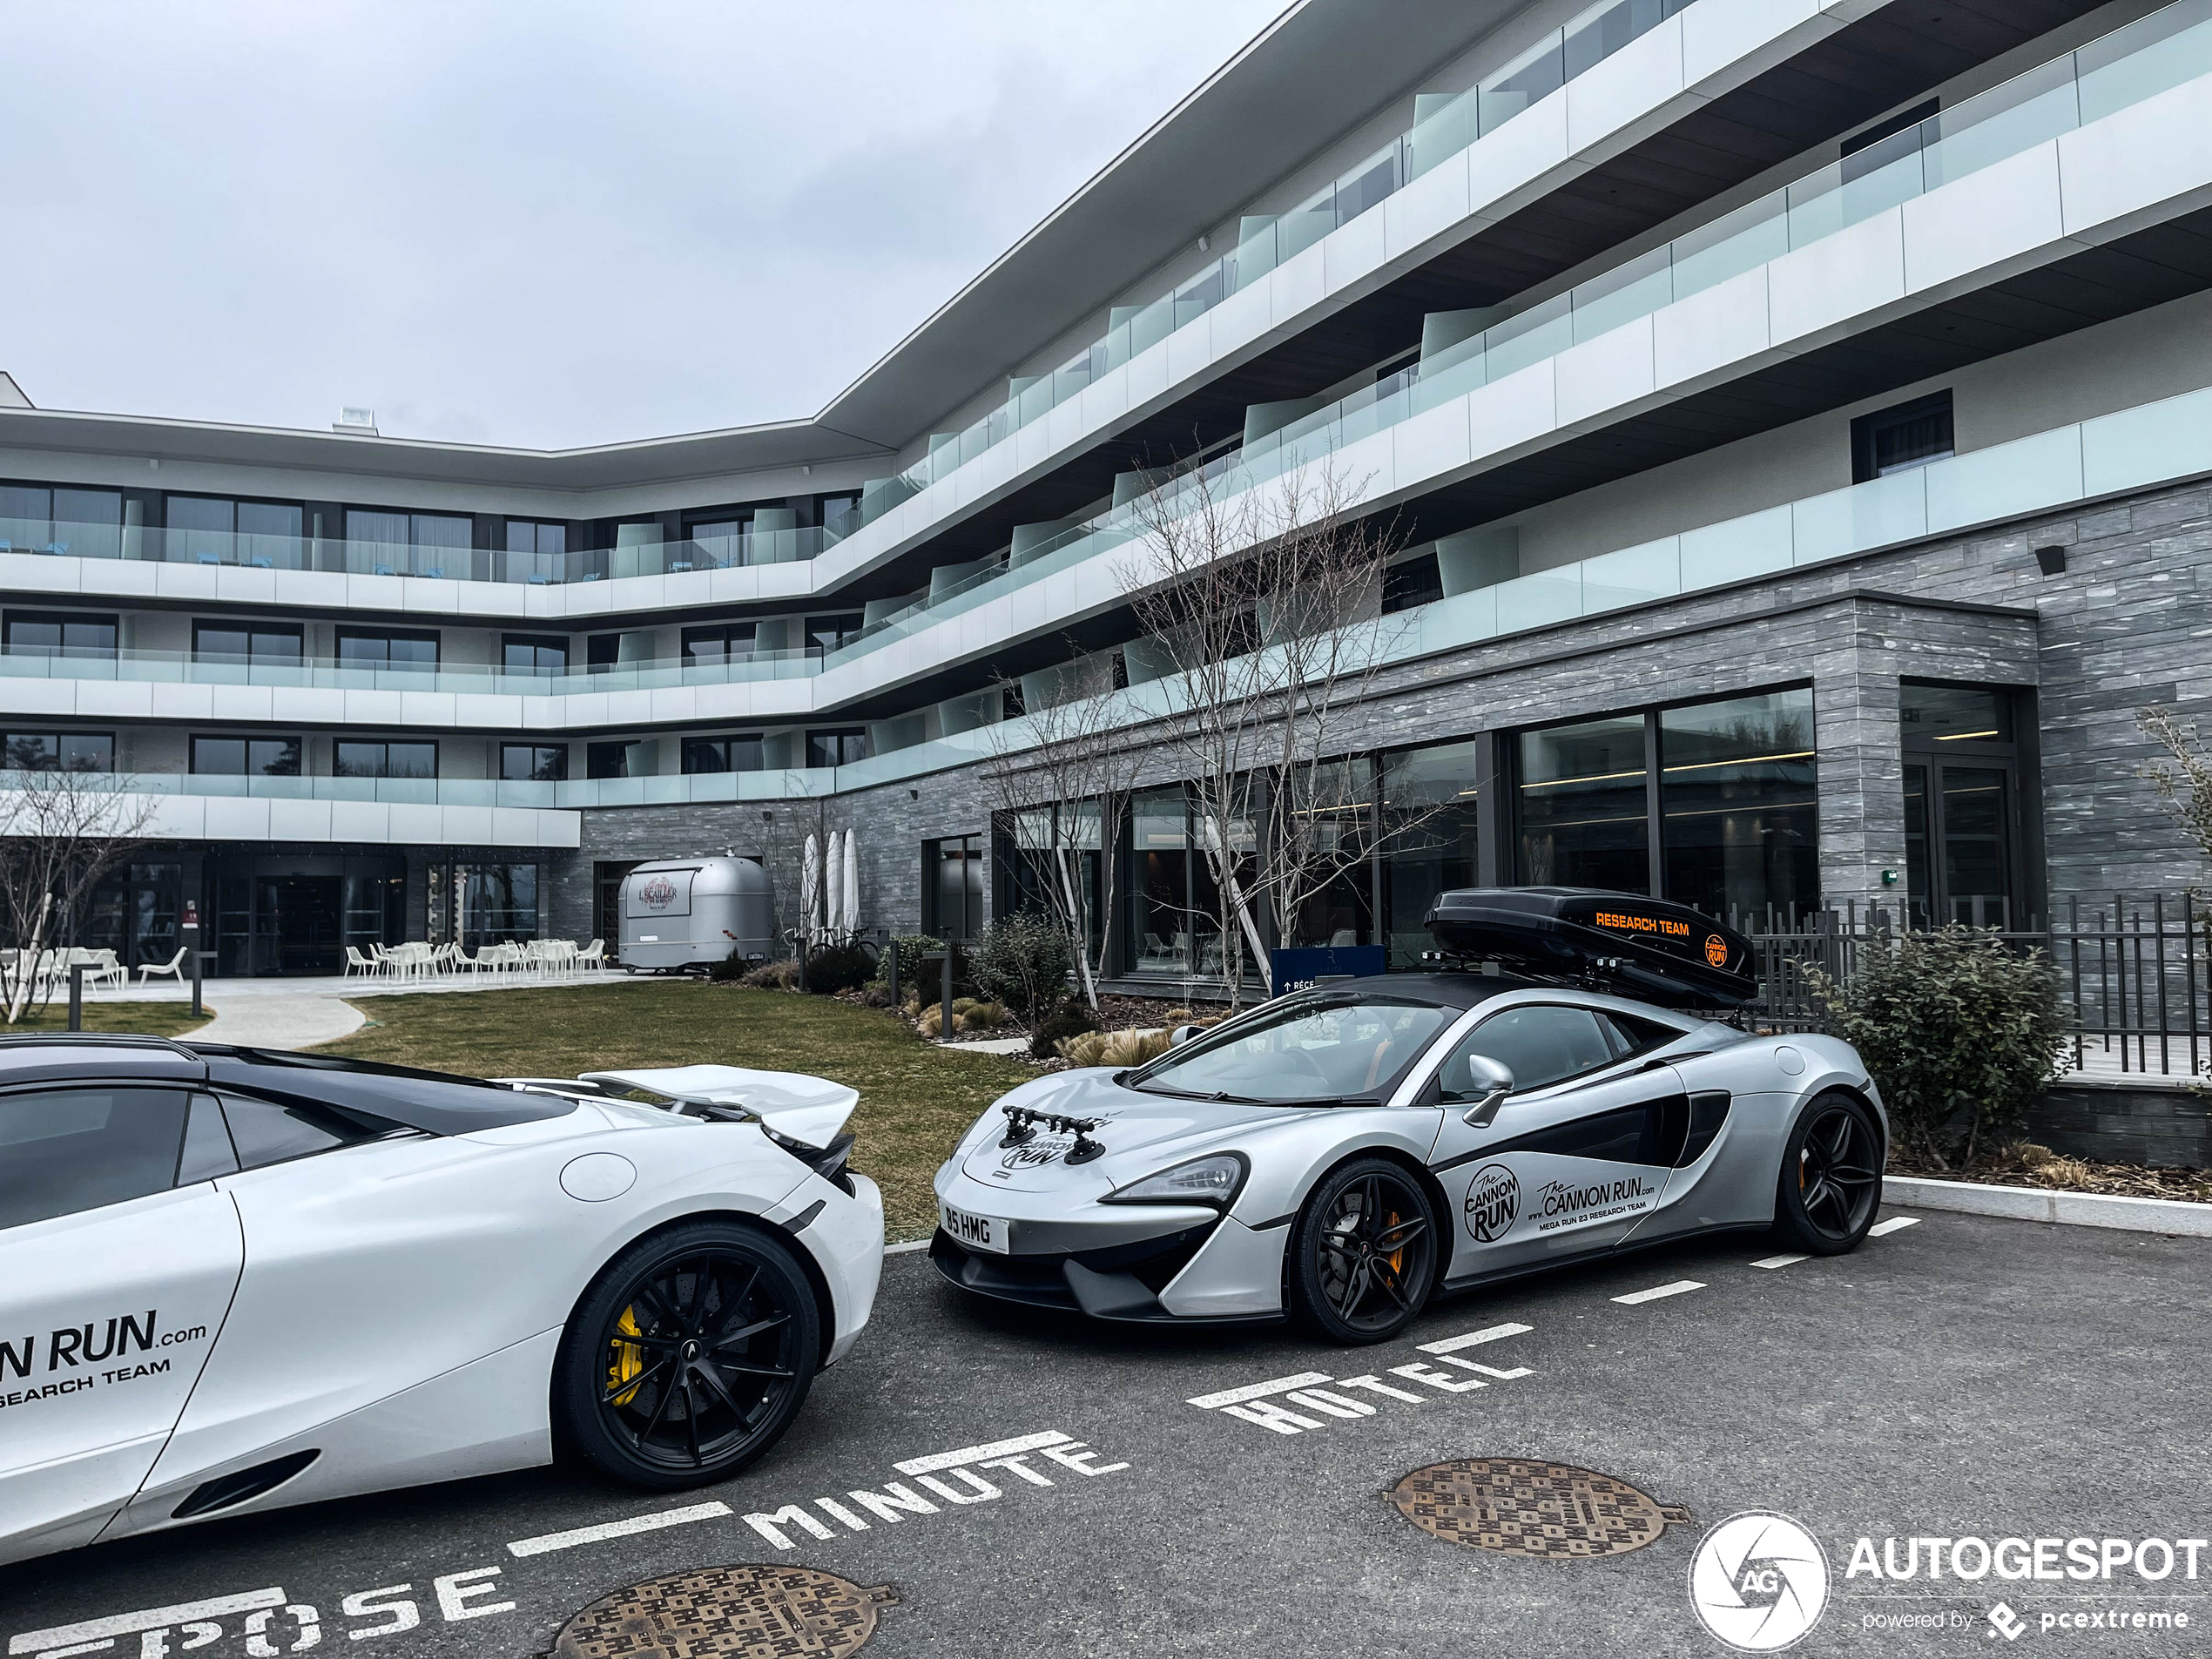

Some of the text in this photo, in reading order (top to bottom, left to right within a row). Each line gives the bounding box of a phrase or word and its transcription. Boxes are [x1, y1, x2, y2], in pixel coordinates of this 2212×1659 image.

[1596, 913, 1689, 936] RESEARCH TEAM
[1706, 942, 1727, 951] CANNON
[1709, 950, 1724, 966] RUN
[1019, 1142, 1074, 1150] CANNON
[1003, 1150, 1061, 1168] RUN
[1465, 1177, 1516, 1213] CANNON
[1477, 1174, 1503, 1191] The
[1537, 1180, 1575, 1204] The
[946, 1206, 989, 1244] B5 HMG
[1471, 1195, 1514, 1242] RUN
[1539, 1222, 1560, 1231] MEGA
[1562, 1217, 1577, 1227] RUN
[1589, 1206, 1626, 1220] RESEARCH
[1627, 1202, 1647, 1211] TEAM
[102, 1359, 171, 1385] TEAM
[1220, 1355, 1537, 1435] HOTEL
[741, 1442, 1130, 1550] MINUTE
